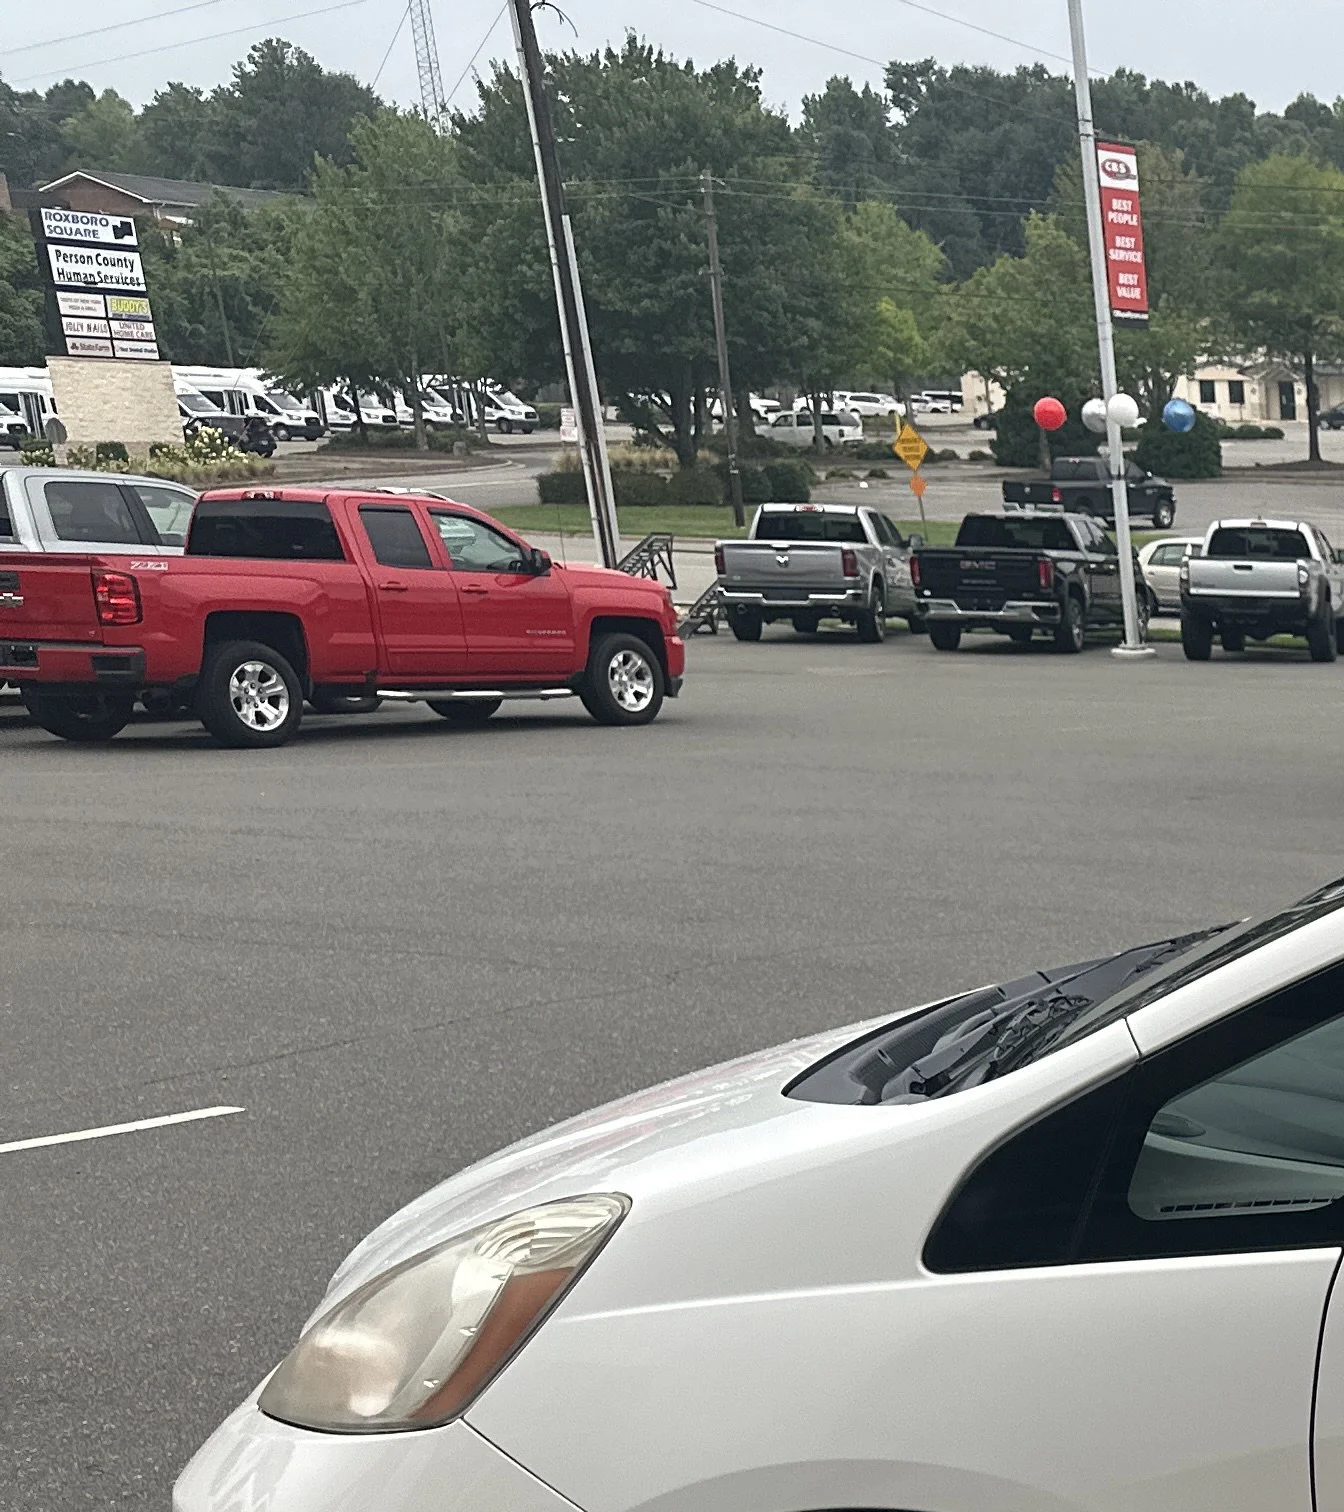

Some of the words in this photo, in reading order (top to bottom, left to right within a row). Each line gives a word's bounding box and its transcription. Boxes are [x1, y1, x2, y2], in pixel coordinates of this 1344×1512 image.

[1112, 198, 1133, 212] BEST
[44, 211, 109, 227] ROXBORO
[1108, 211, 1138, 226] PEOPLE
[46, 224, 100, 239] SQUARE
[1115, 235, 1136, 249] BEST
[54, 249, 94, 265] Person
[95, 253, 135, 273] County
[56, 267, 96, 283] Human
[96, 271, 141, 286] Services
[1118, 272, 1139, 286] BEST
